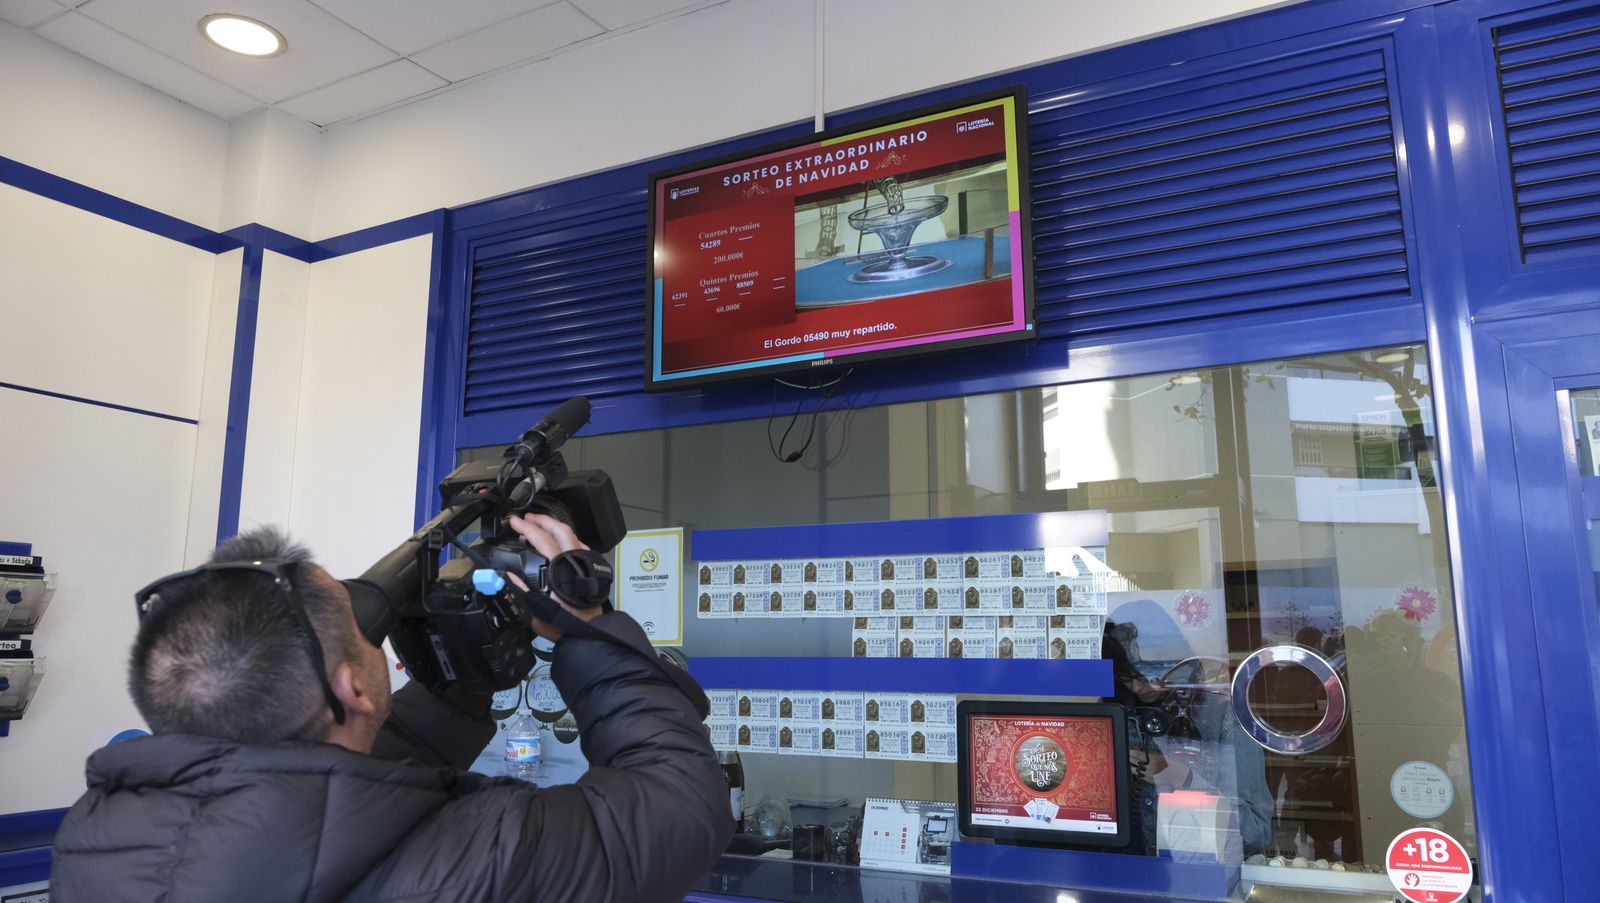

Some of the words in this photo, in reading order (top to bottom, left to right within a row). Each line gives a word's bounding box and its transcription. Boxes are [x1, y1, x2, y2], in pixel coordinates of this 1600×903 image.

[968, 118, 989, 126] LOTERÍA
[968, 121, 995, 130] NACIONAL
[723, 165, 779, 187] SORTEO
[786, 130, 928, 173] EXTRAORDINARIO
[775, 176, 793, 189] DE
[799, 159, 870, 184] NAVIDAD
[698, 229, 728, 240] Cuartos
[730, 222, 761, 233] Premios
[700, 239, 721, 250] 54289
[713, 251, 744, 264] 200.000€
[699, 276, 727, 288] Quintos
[729, 270, 759, 281] Premios
[716, 302, 742, 314] 60.000€
[764, 339, 773, 349] El
[774, 335, 801, 347] Gordo
[803, 331, 829, 342] 05490
[831, 329, 851, 340] muy
[853, 321, 898, 336] repartido.
[811, 358, 834, 367] PHILIPS
[1023, 751, 1058, 767] SORTEO
[1403, 837, 1450, 863] +18
